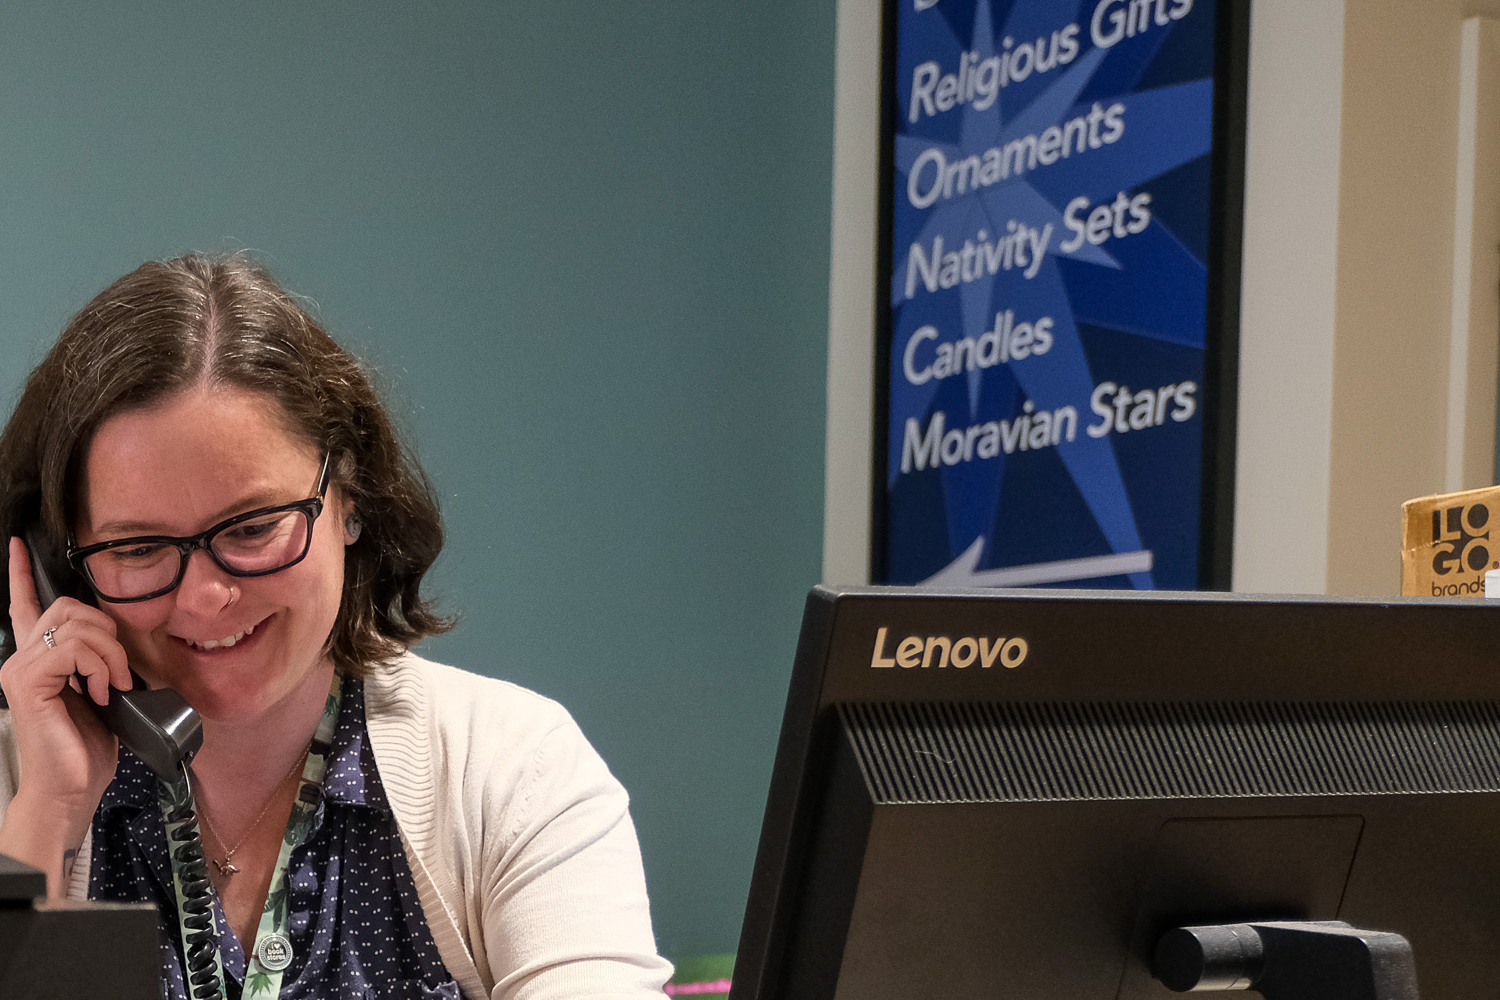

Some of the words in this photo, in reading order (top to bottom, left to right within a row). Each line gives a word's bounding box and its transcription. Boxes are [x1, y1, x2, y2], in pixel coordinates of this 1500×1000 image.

[908, 22, 1080, 124] Religious
[1090, 0, 1195, 49] Gifts
[907, 100, 1126, 209] Ornaments
[905, 219, 1053, 299] Nativity
[1060, 191, 1153, 254] Sets
[902, 309, 1054, 386] Candles
[900, 399, 1078, 474] Moravian
[1086, 379, 1198, 439] Stars
[1431, 575, 1486, 598] brands
[870, 627, 1029, 669] Lenovo
